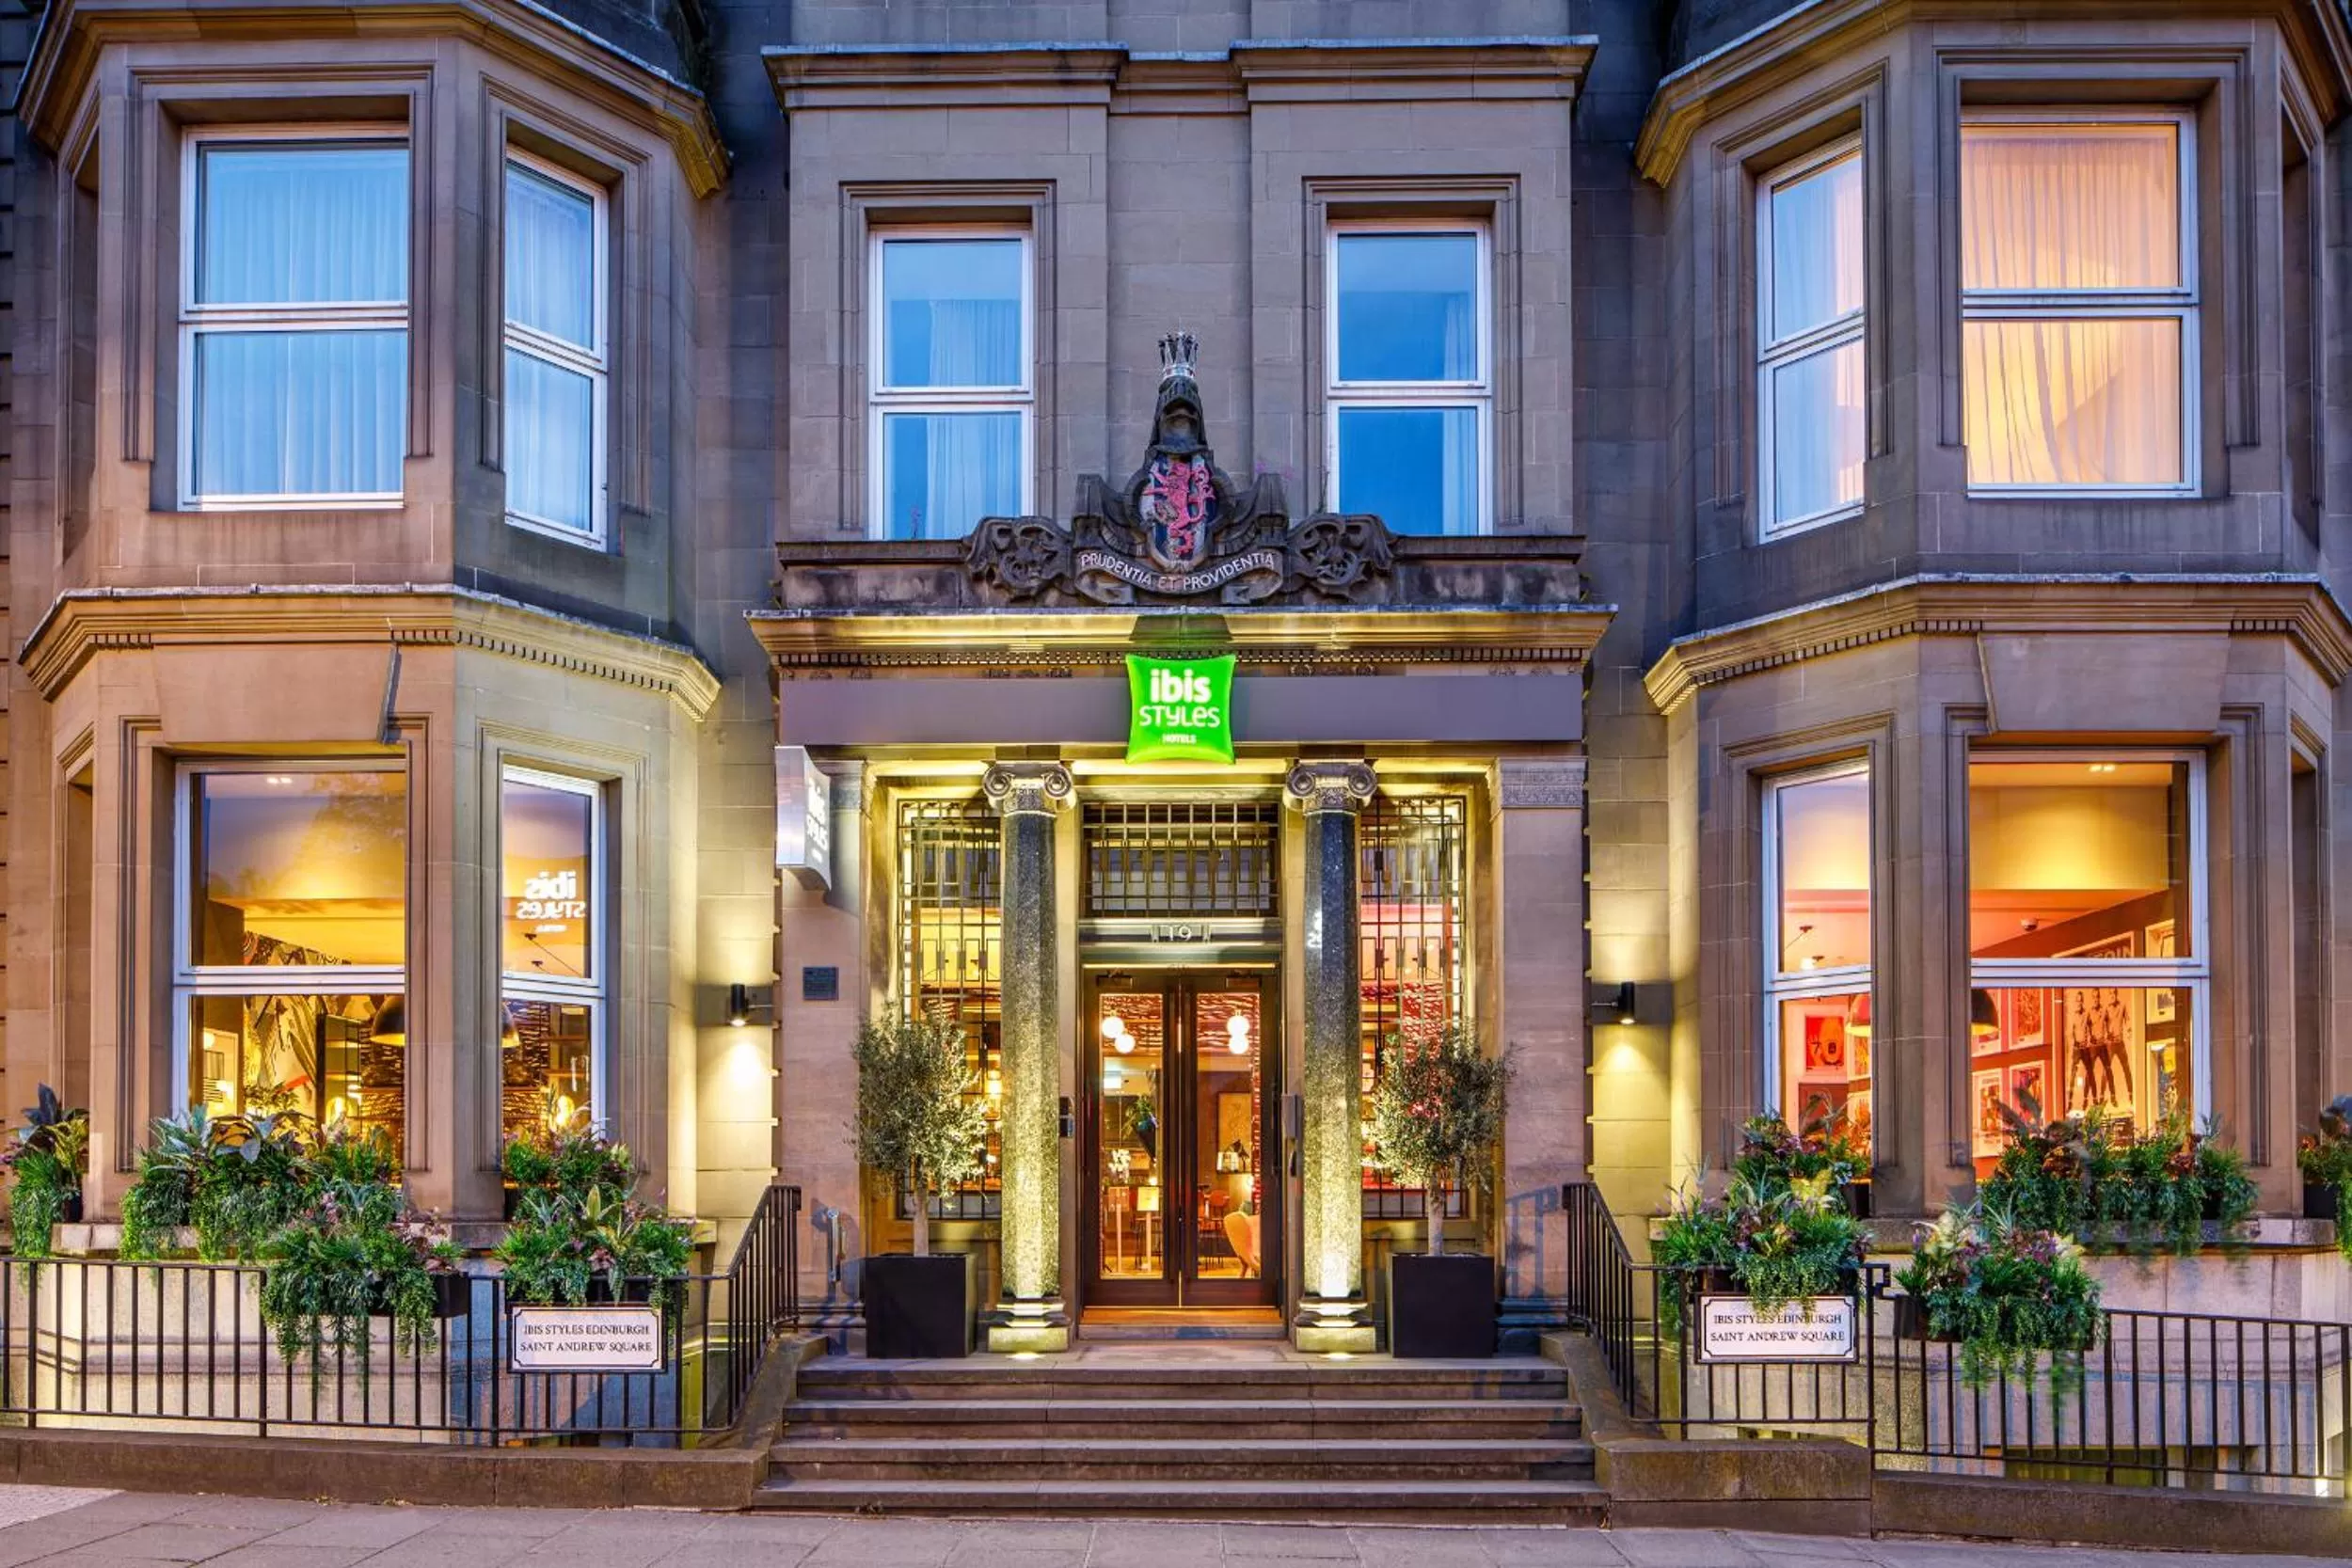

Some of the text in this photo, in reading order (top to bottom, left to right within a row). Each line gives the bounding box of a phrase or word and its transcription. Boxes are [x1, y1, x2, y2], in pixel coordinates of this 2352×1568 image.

[1080, 552, 1275, 591] PRUDENTIA ET PROVIDENTIA
[1150, 669, 1212, 703] ibis
[1169, 926, 1192, 942] 19
[1713, 1314, 1733, 1324] IBIS
[524, 1324, 649, 1335] IBIS STYLES EDINBURGH
[1710, 1331, 1845, 1342] SAINT ANDREW SQUARE
[520, 1341, 653, 1354] SAINT ANDREW SQUARE
